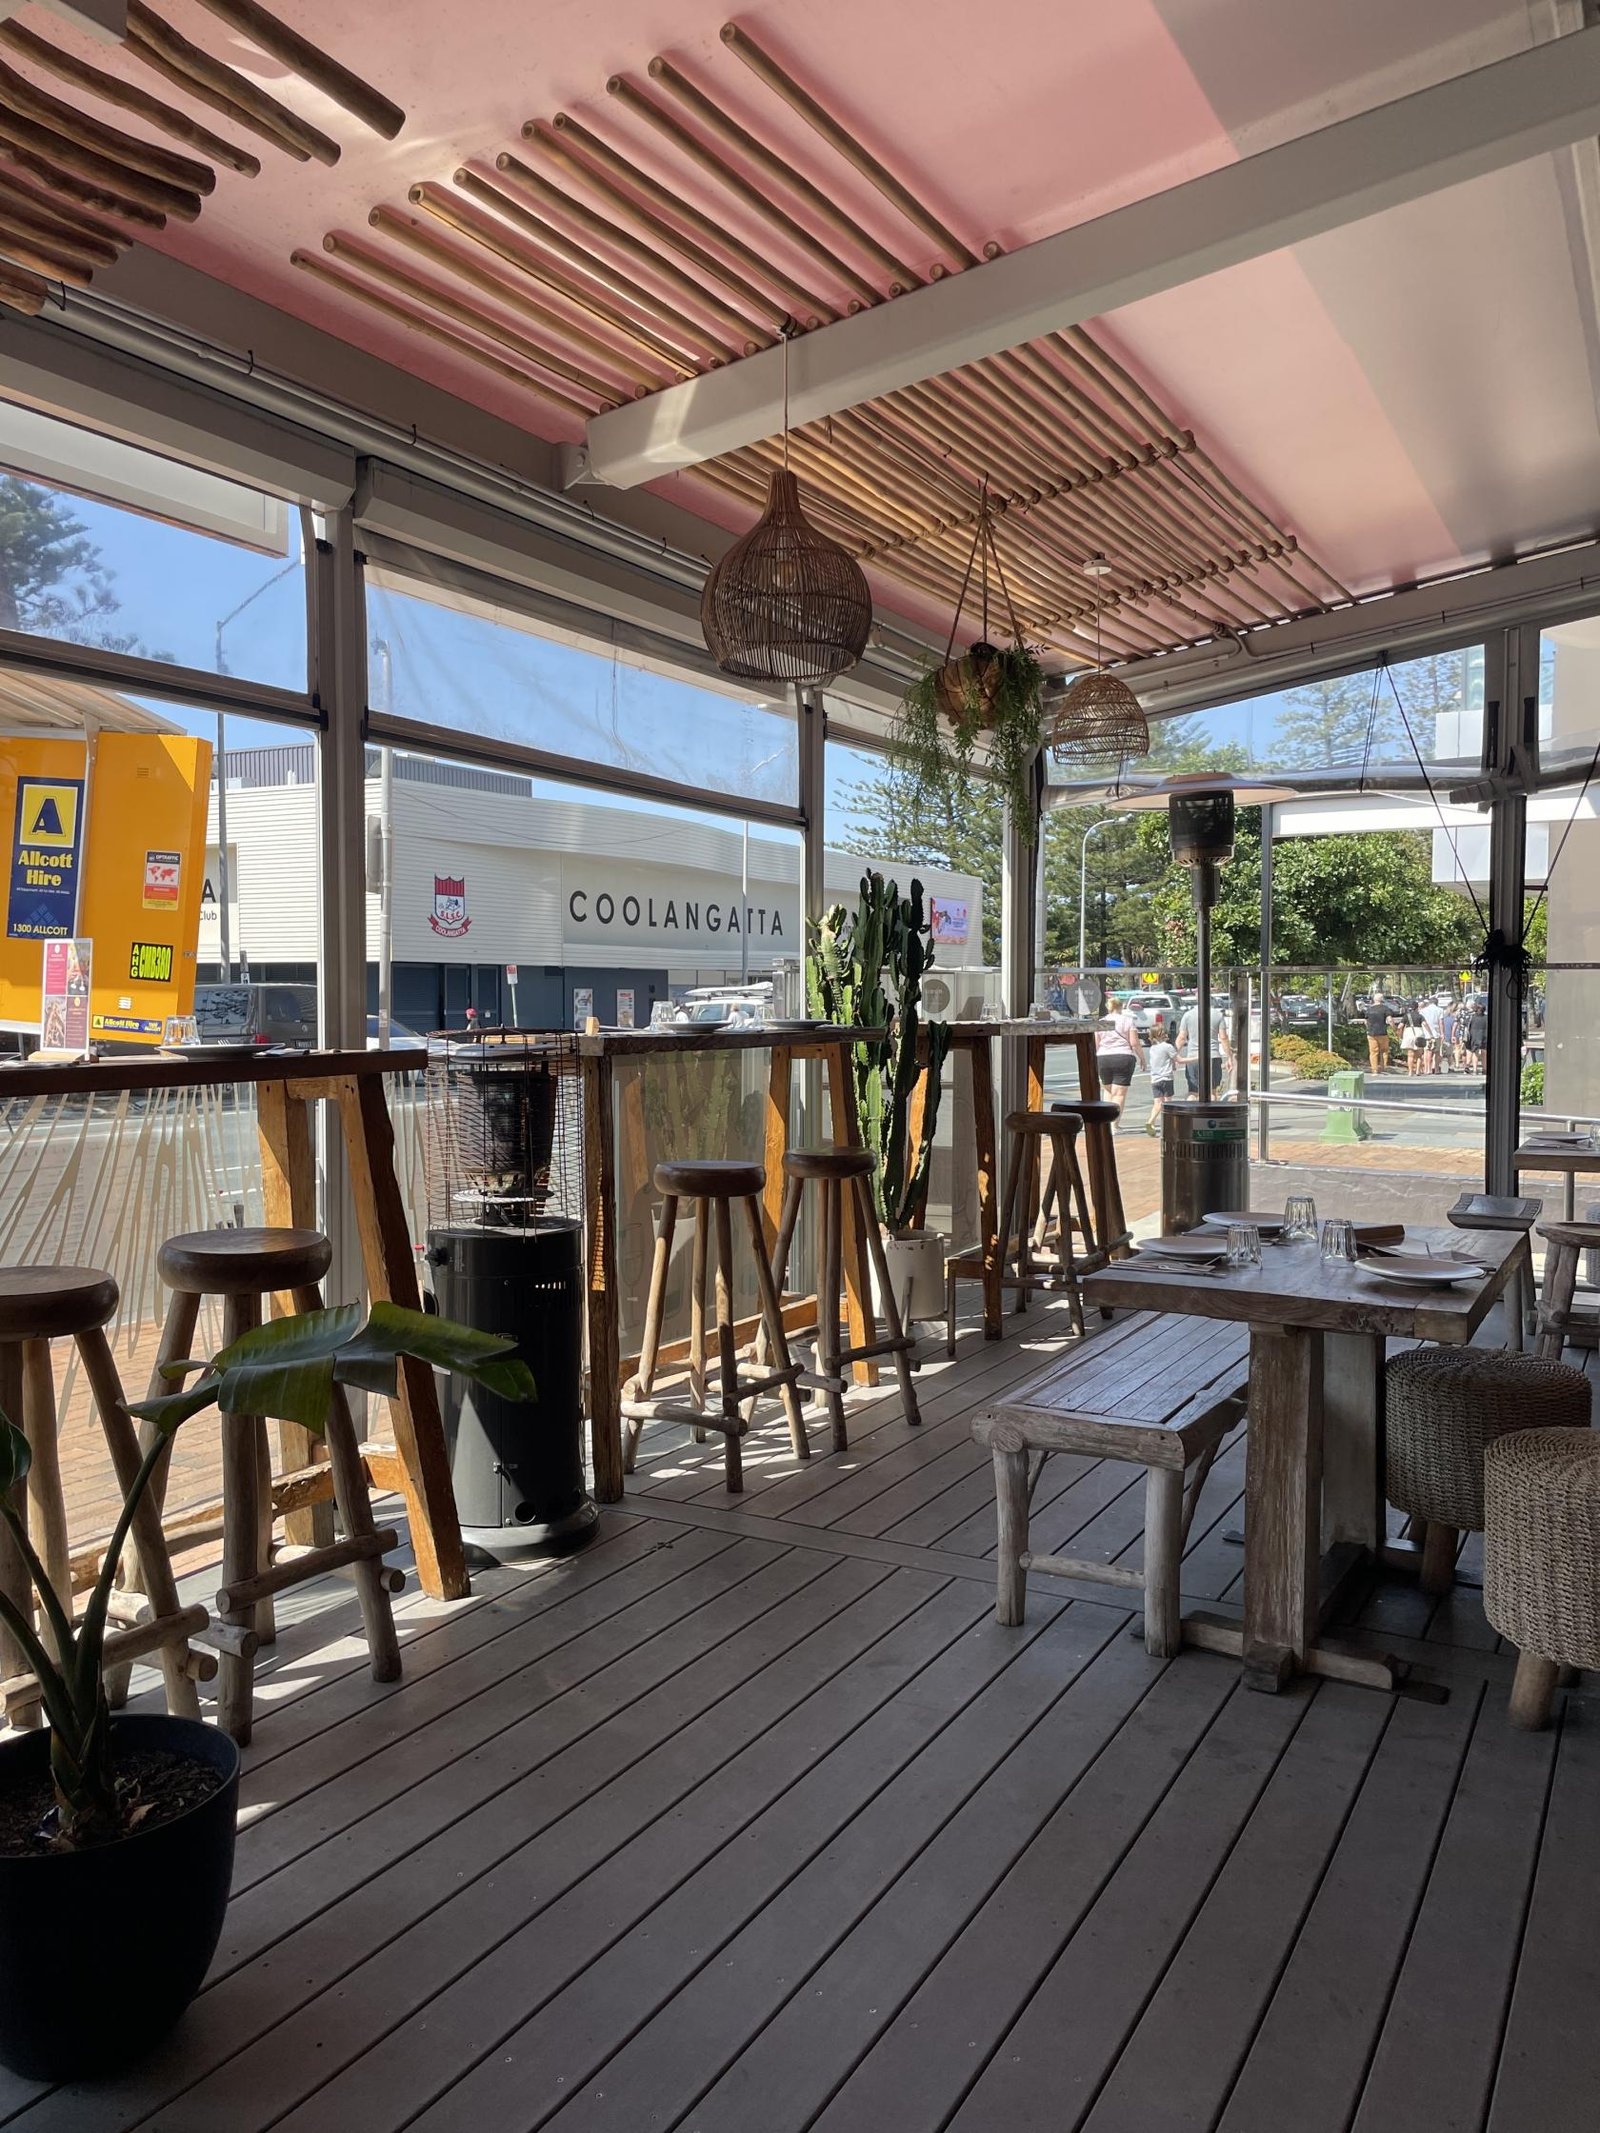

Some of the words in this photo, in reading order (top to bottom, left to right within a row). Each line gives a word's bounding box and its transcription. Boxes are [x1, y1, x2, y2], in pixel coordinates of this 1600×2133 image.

[30, 797, 65, 836] A
[18, 850, 73, 868] Allcott
[26, 869, 62, 886] Hire
[569, 890, 783, 936] COOLANGATTA
[13, 923, 32, 934] 1300
[33, 925, 68, 936] ALLCOTT
